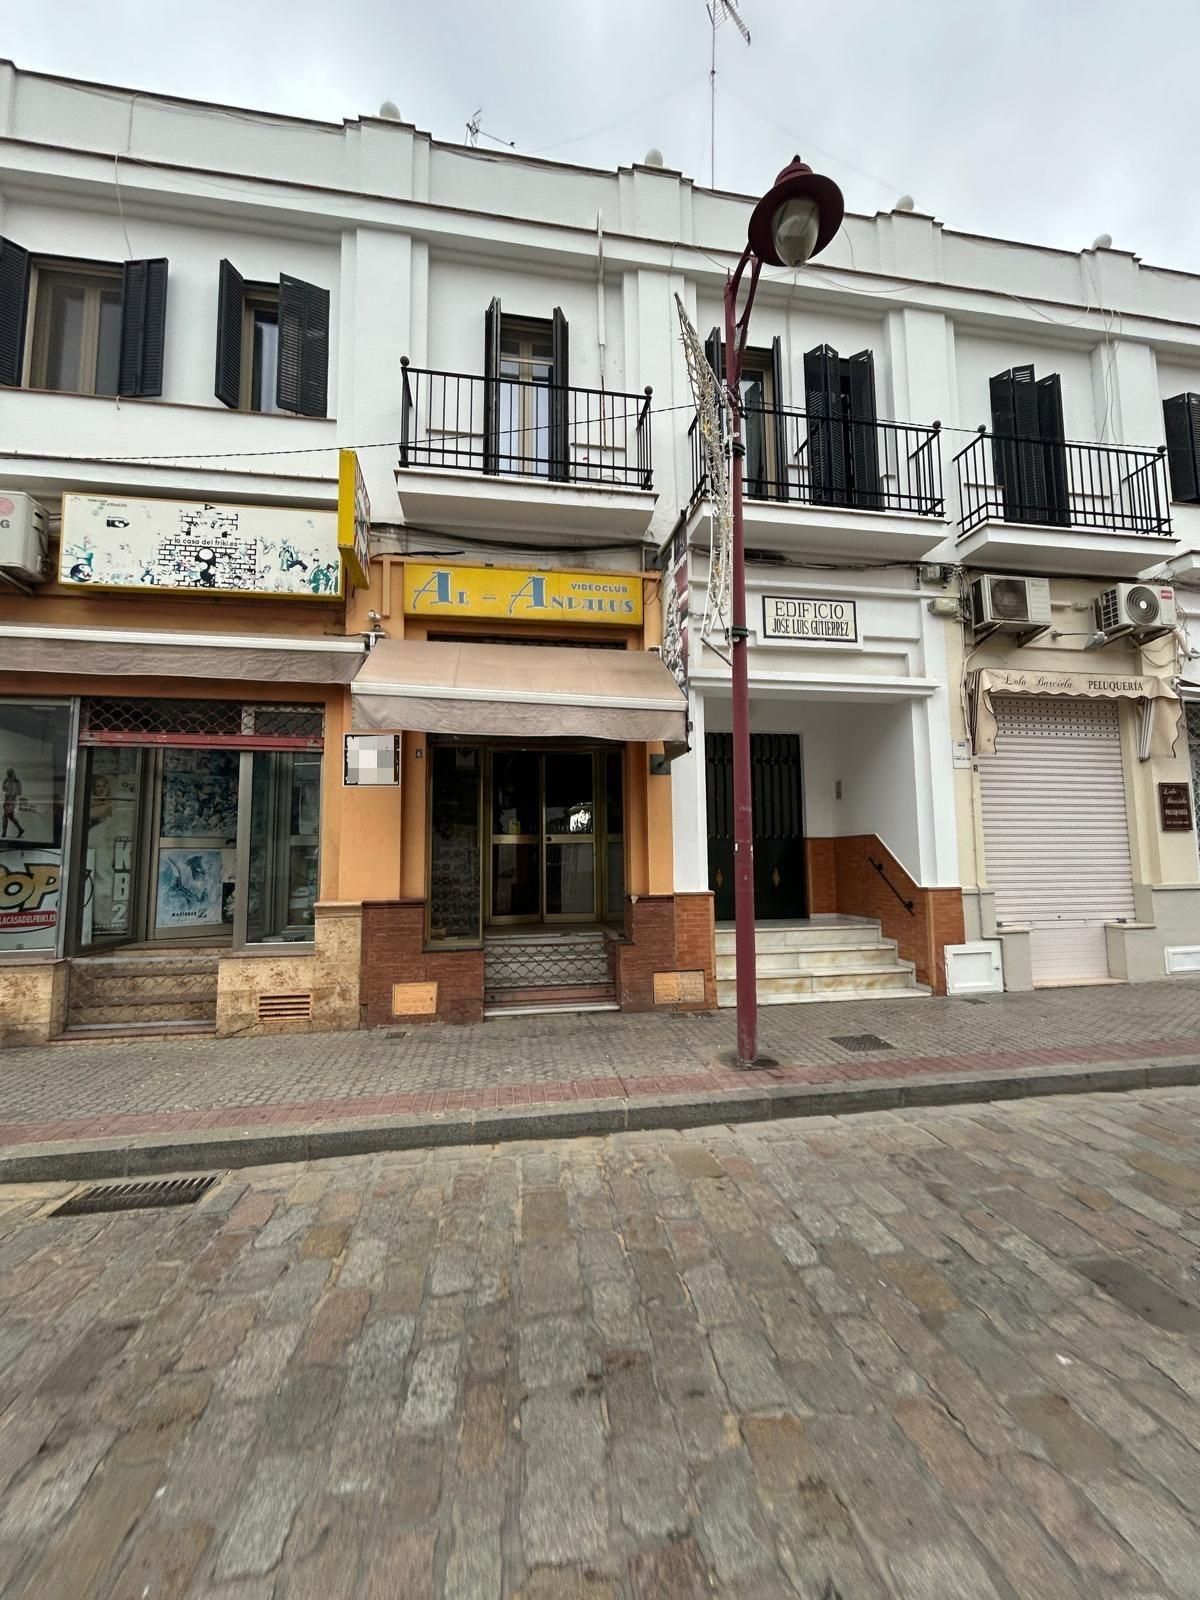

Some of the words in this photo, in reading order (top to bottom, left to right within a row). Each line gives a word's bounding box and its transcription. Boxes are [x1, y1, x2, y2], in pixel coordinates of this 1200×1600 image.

[174, 536, 181, 544] la
[571, 583, 628, 593] VIDEOCLUB
[775, 601, 844, 620] EDIFICIO
[772, 618, 791, 634] JOSE
[792, 619, 809, 635] LUIS
[811, 621, 849, 637] GUTIERREZ
[1001, 673, 1027, 686] Lola
[1088, 680, 1144, 693] PELUQUERÍA
[0, 863, 61, 911] OP
